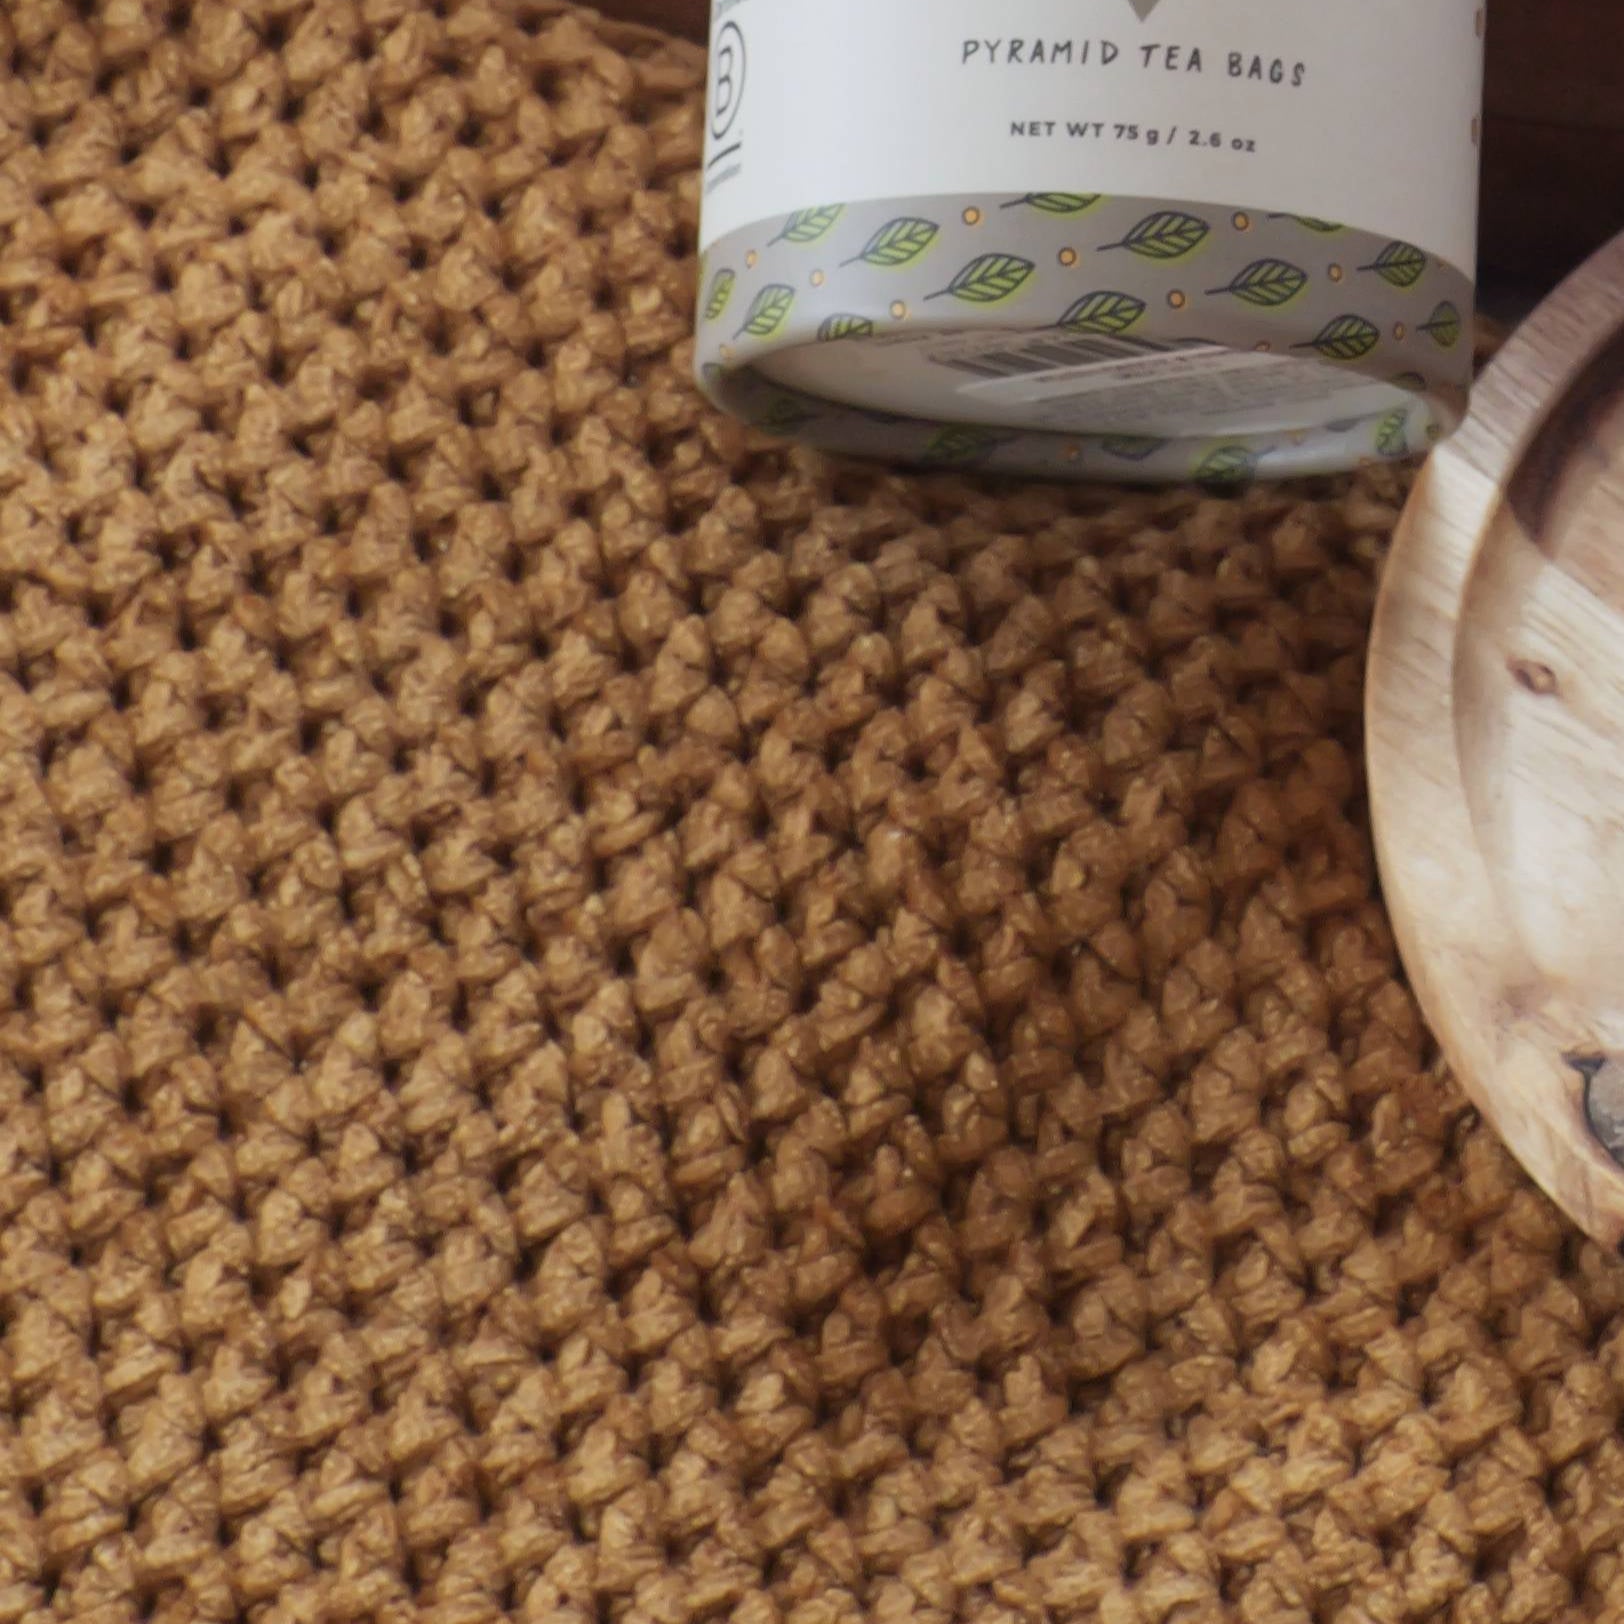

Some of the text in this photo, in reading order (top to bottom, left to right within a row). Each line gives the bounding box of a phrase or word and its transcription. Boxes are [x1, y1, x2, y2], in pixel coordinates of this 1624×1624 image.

[961, 38, 1307, 88] PYRAMID TEA BAGS
[1009, 120, 1056, 137] NET
[1066, 121, 1105, 139] WT
